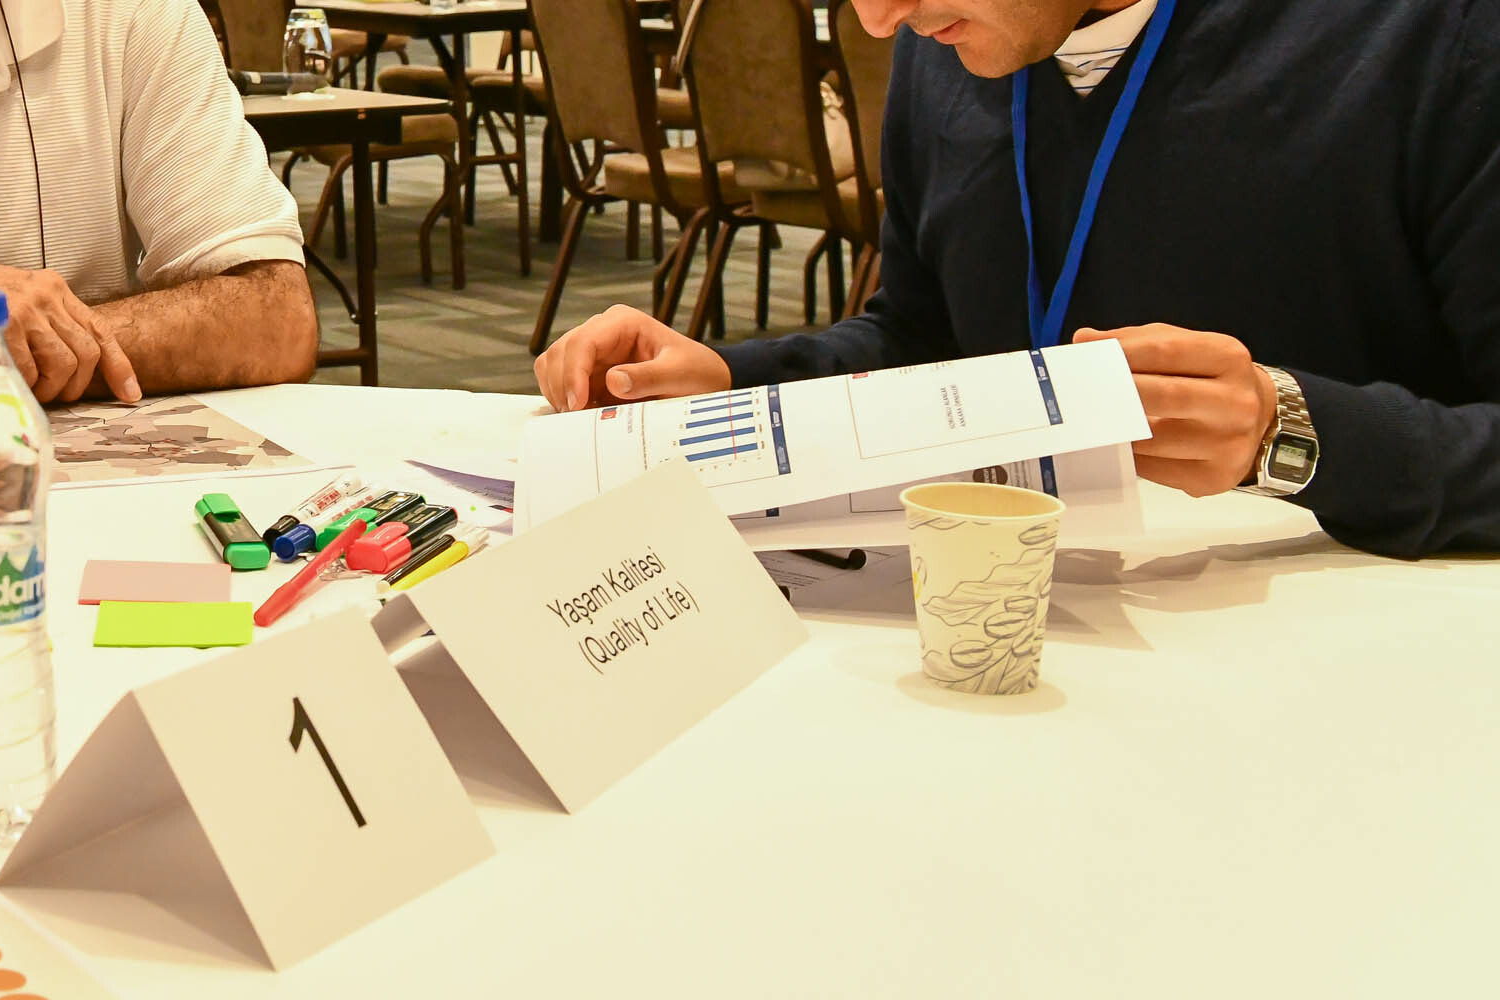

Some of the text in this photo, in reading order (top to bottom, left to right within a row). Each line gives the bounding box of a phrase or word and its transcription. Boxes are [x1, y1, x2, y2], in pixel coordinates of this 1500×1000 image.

[545, 545, 667, 628] Yaşam Kalitesi
[578, 581, 701, 676] (Quality of Life)
[287, 695, 368, 829] 1
